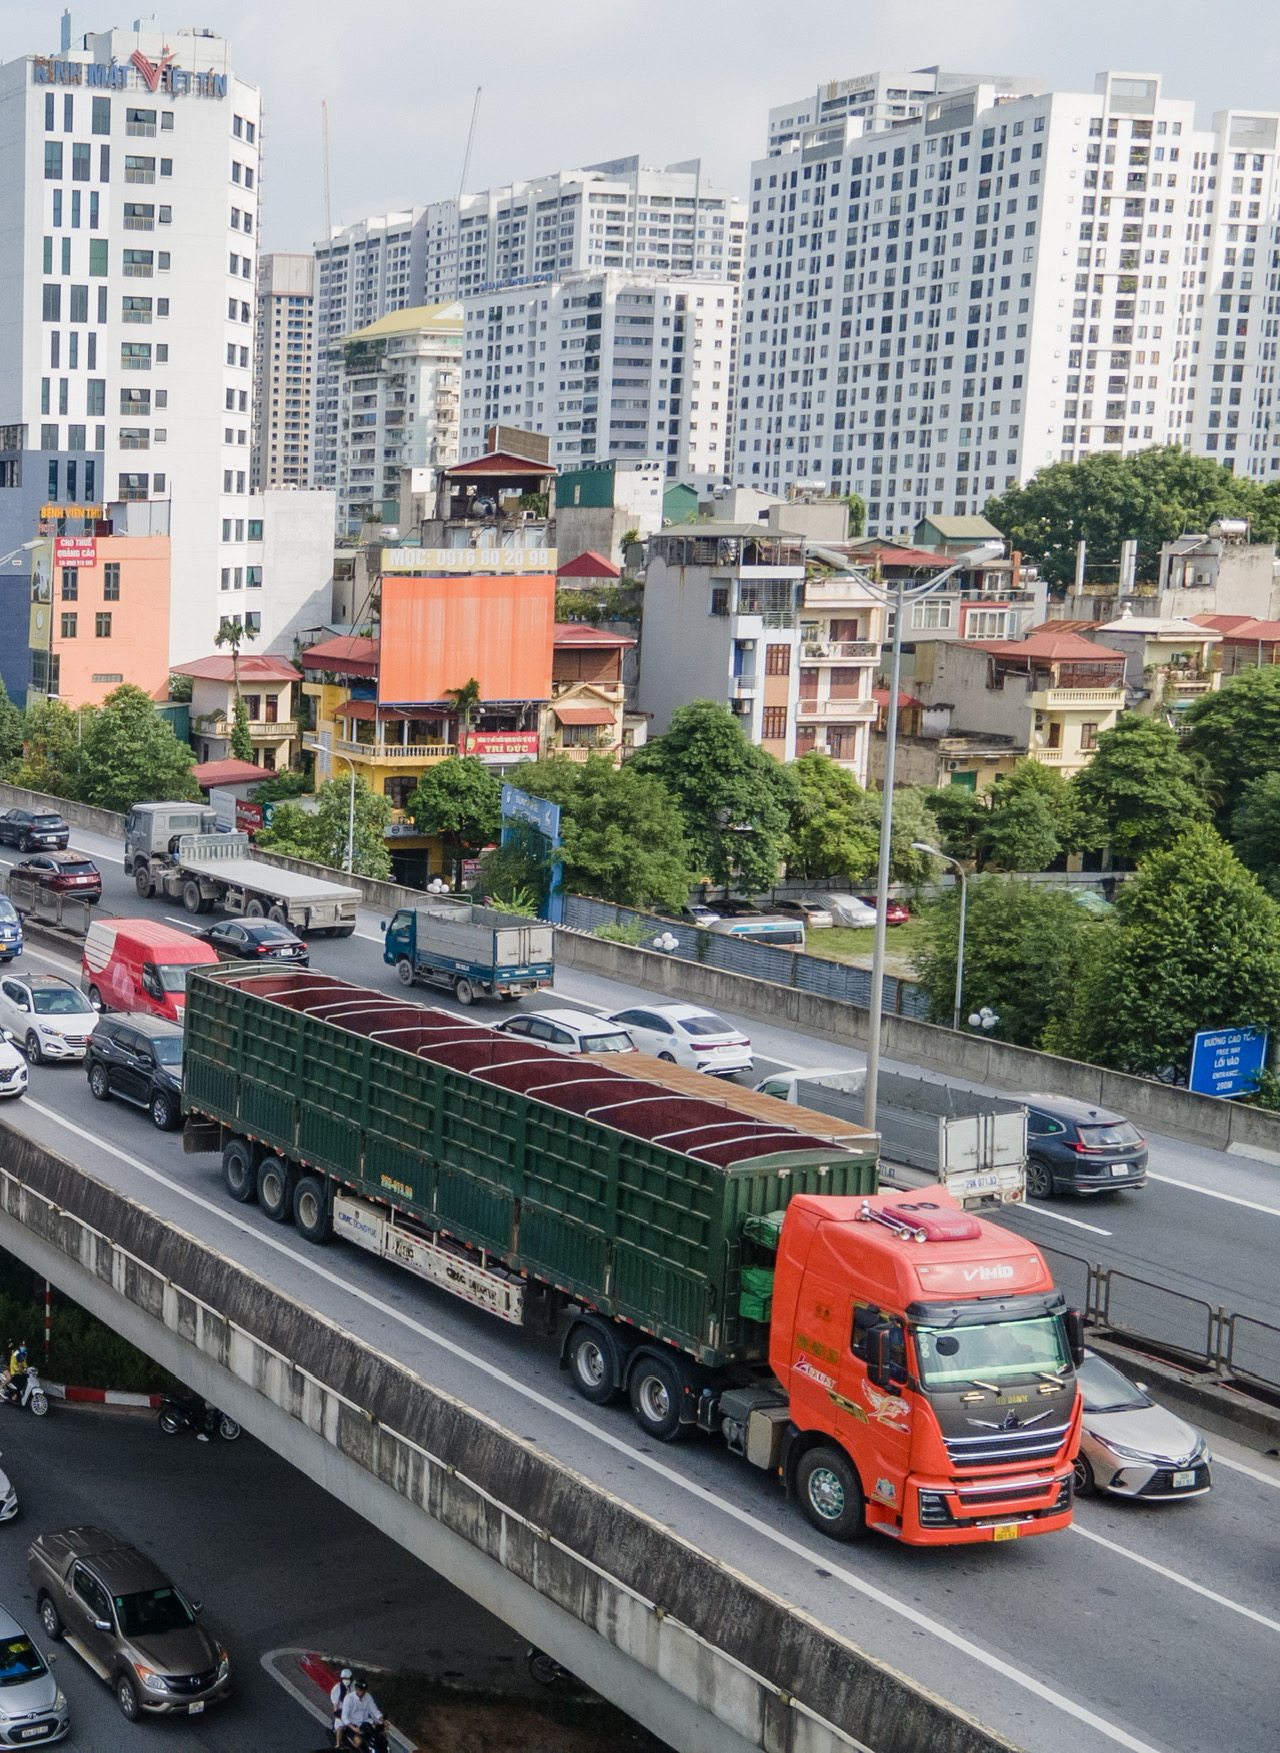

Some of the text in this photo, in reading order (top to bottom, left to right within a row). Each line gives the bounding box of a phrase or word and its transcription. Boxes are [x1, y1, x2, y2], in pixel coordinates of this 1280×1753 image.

[60, 538, 74, 547] CHO
[390, 549, 548, 567] MQC: 0916 80 20 99
[1228, 1034, 1241, 1044] CAO
[1214, 1055, 1240, 1068] LỐI VÀO
